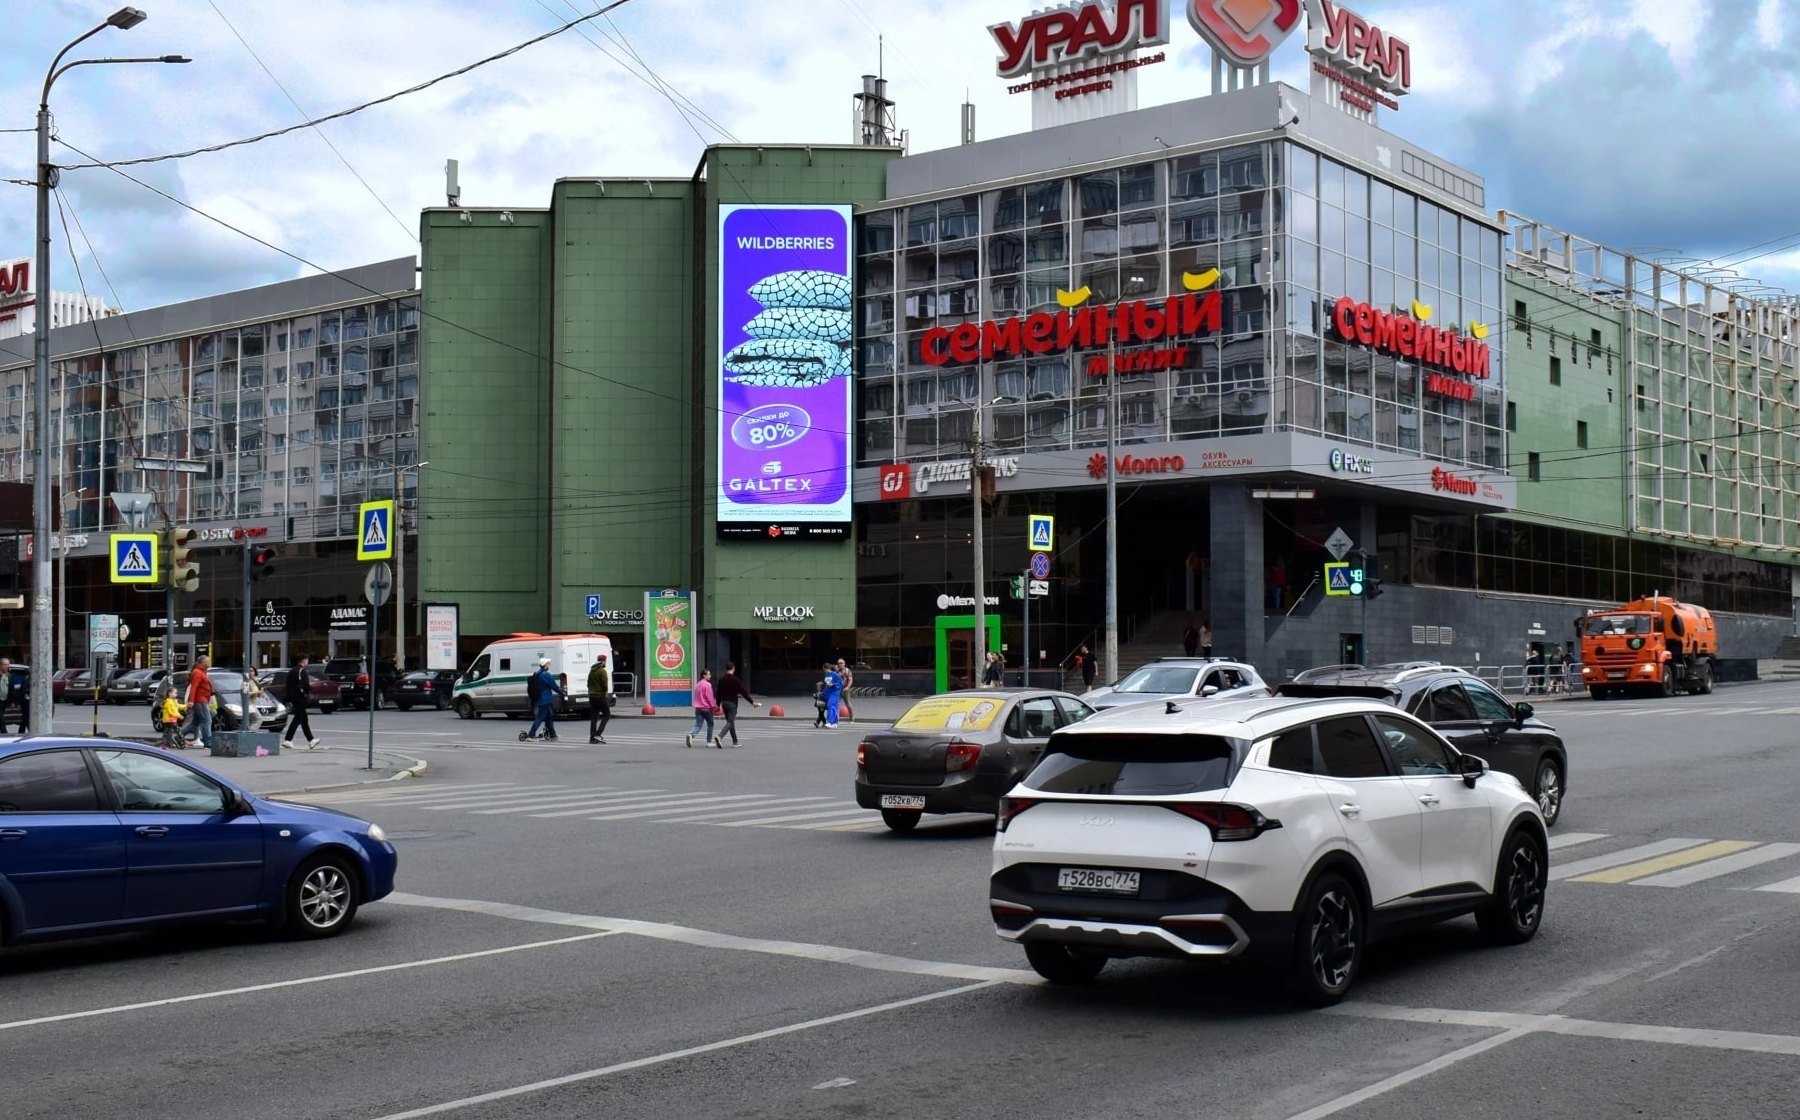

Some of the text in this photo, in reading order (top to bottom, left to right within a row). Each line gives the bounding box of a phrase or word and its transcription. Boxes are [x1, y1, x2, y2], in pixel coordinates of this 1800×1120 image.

[995, 0, 1161, 72] УРАЛ
[1320, 0, 1410, 88] УРАЛ
[737, 236, 835, 250] WILDBERRIES
[749, 421, 795, 444] 80%
[1202, 451, 1228, 460] ОБУВЬ
[1115, 454, 1186, 475] Monro
[1202, 458, 1253, 469] АКСЕССУАРЫ
[729, 478, 811, 491] GALTEX
[883, 471, 904, 492] GJ
[1350, 569, 1363, 582] 48
[589, 597, 598, 613] P
[948, 596, 999, 606] МЕГАОН
[331, 607, 366, 618] АДАМАС
[590, 610, 645, 619] OYESHO
[754, 606, 814, 617] MP LOOK
